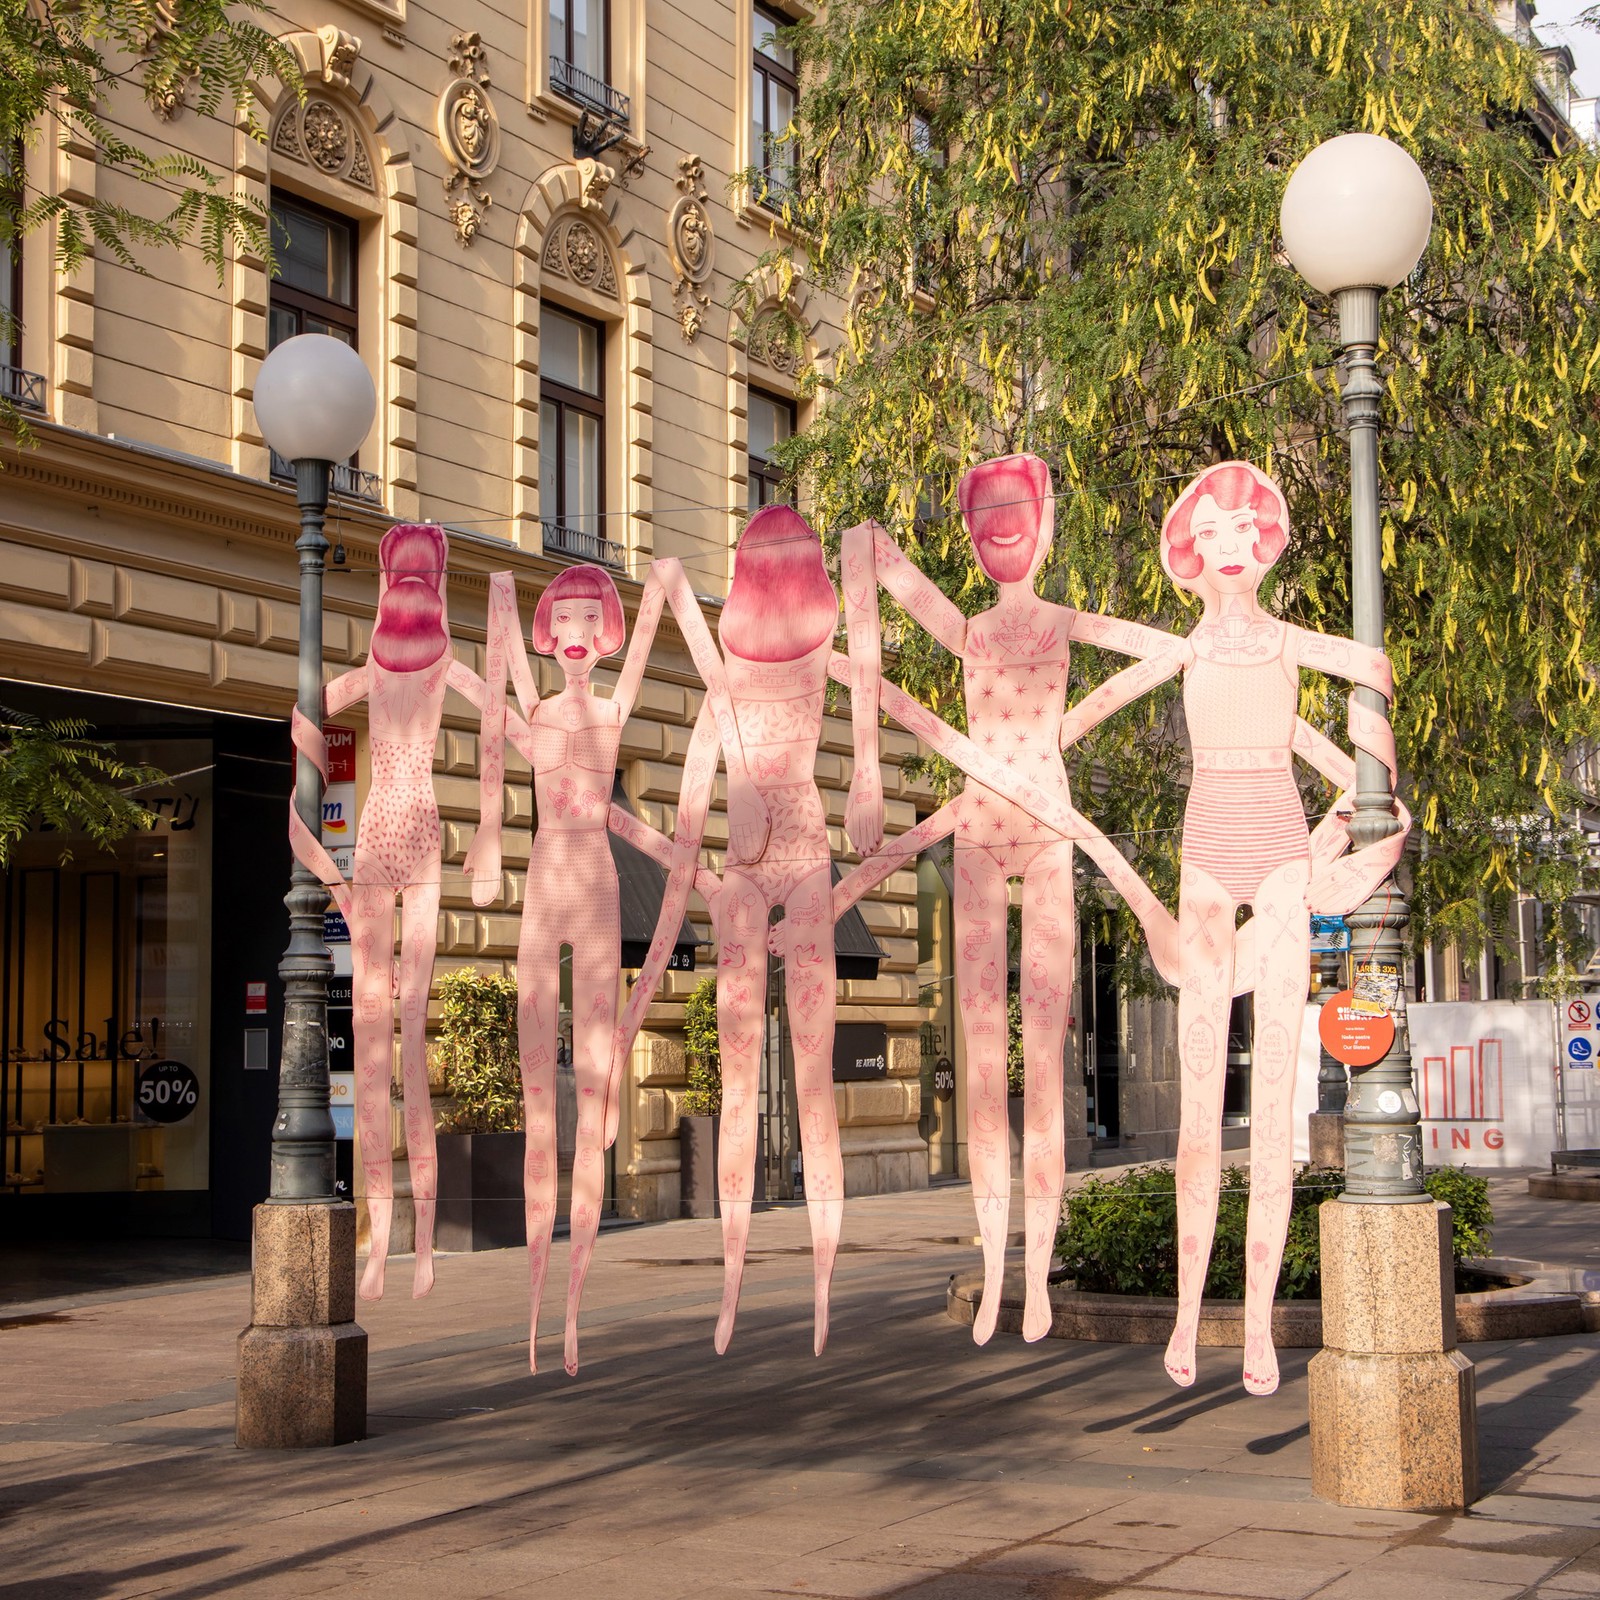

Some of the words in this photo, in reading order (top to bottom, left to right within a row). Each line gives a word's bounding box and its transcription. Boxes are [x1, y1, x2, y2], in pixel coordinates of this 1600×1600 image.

[325, 733, 352, 747] ZUM
[322, 802, 342, 820] m
[43, 1017, 160, 1062] Sale!
[920, 1024, 947, 1056] ale!
[935, 1071, 954, 1089] 50%
[139, 1079, 197, 1105] 50%
[1432, 1128, 1504, 1150] ING
